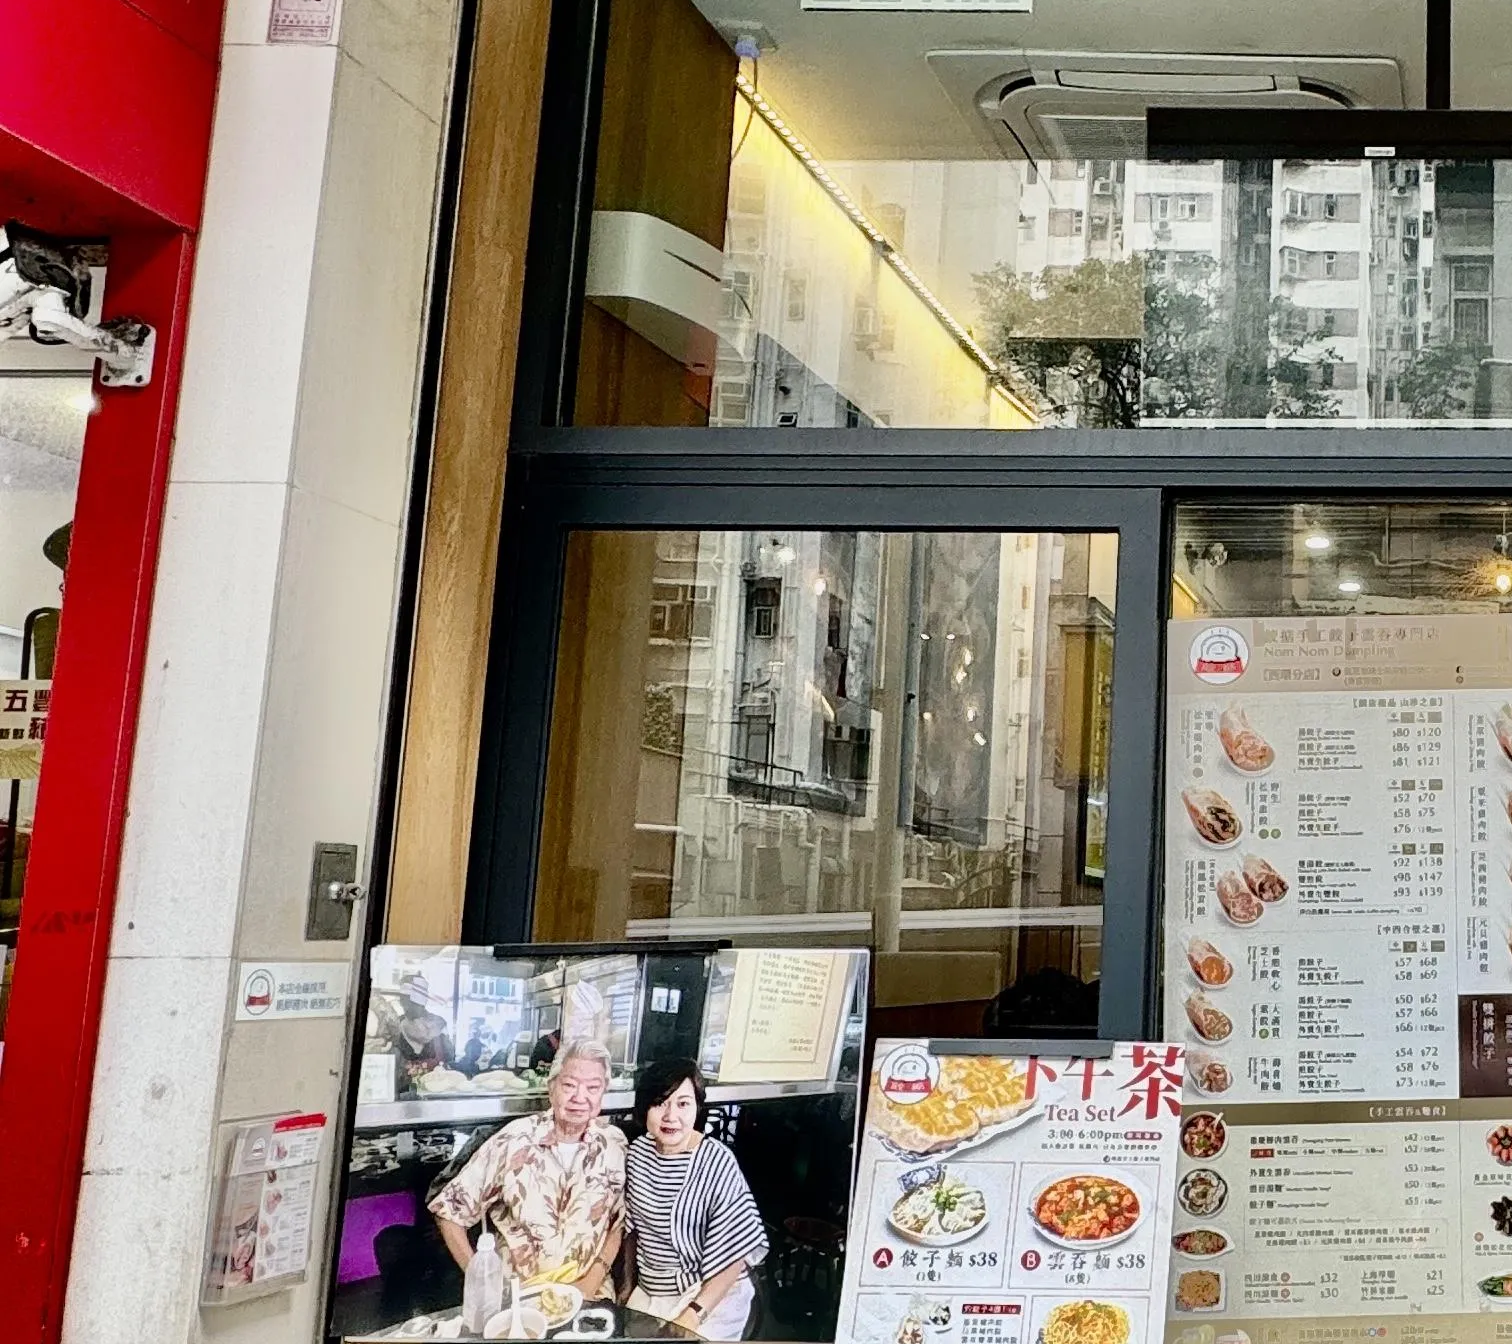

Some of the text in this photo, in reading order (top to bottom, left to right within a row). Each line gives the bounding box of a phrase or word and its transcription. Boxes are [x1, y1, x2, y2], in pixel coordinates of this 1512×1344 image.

[1264, 645, 1395, 658] Nom Nom Dumpling
[1417, 728, 1441, 737] $120
[1417, 757, 1441, 767] $121
[1393, 793, 1436, 803] $52 $70
[1393, 808, 1435, 818] $58 $75
[1393, 824, 1411, 834] $76
[1393, 857, 1443, 868] $92 $138
[1393, 872, 1443, 882] $98 $147
[1393, 887, 1444, 897] $93 $139
[1395, 957, 1437, 967] $57 $68
[1395, 970, 1437, 980] $58 $69
[1395, 994, 1438, 1004] $50 $62
[1395, 1008, 1438, 1018] $57 $66
[1395, 1022, 1414, 1032] $66
[1395, 1047, 1439, 1057] $54 $72
[1396, 1061, 1439, 1072] $58 $76
[1396, 1077, 1414, 1088] $73
[1044, 1104, 1118, 1122] Tea Set
[877, 1250, 998, 1269] A 餃子麵 $38
[1025, 1251, 1146, 1271] B 雲吞麵 $38
[1320, 1273, 1338, 1283] $32
[1426, 1270, 1443, 1280] $21
[1320, 1287, 1339, 1298] $30
[1427, 1286, 1445, 1296] $25
